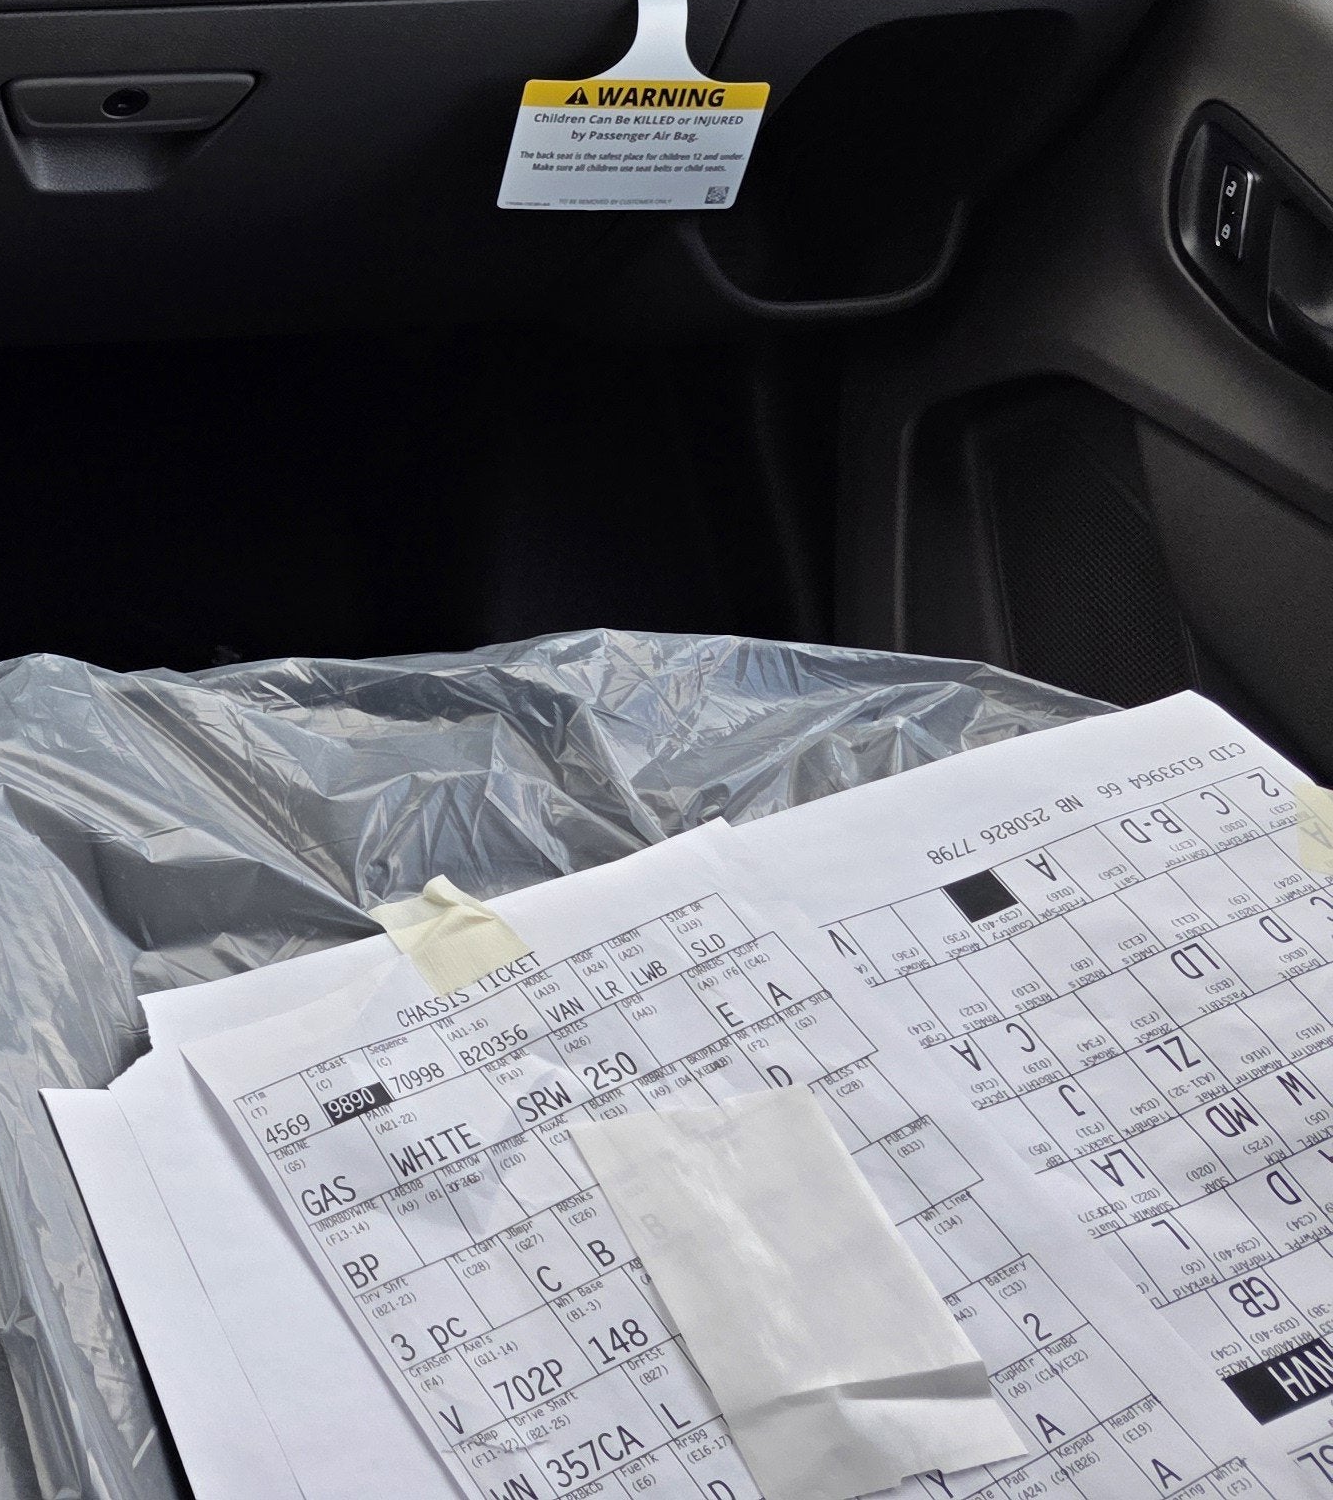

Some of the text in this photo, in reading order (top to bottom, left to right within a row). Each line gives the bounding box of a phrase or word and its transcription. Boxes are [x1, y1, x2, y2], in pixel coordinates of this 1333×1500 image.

[597, 86, 727, 108] WARNING
[533, 112, 744, 128] Children Can Be KILLED or INJURED
[570, 130, 699, 144] by Passenger Air Bag.
[520, 150, 535, 159] The
[536, 151, 554, 160] back
[556, 152, 573, 160] seat
[583, 152, 597, 160] the
[598, 152, 622, 161] safest
[622, 153, 644, 162] place
[645, 153, 657, 161] for
[658, 152, 691, 161] children
[703, 152, 719, 161] and
[719, 153, 745, 161] under.
[531, 163, 554, 171] Make
[555, 164, 574, 172] sure
[574, 163, 585, 172] all
[586, 164, 619, 172] children
[653, 165, 673, 173] belts
[684, 164, 704, 173] child
[704, 165, 727, 173] seats.
[926, 742, 1246, 865] CID 6193964 66 NB 250826 7798
[1199, 790, 1231, 815] C
[1119, 808, 1183, 844] B-D
[1025, 852, 1058, 882] A
[690, 932, 726, 958] SLD
[1258, 915, 1293, 944] D
[631, 959, 668, 987] LWB
[1170, 942, 1221, 980] LD
[595, 979, 624, 1002] LR
[766, 981, 793, 1007] A
[396, 990, 470, 1028] CHASSIS
[545, 996, 586, 1024] VAN
[716, 1001, 744, 1028] E
[459, 1023, 529, 1067] B20356
[1145, 1035, 1202, 1073] ZL
[389, 1061, 445, 1095] 70998
[583, 1051, 639, 1091] 250
[328, 1086, 376, 1119] 9890
[516, 1080, 573, 1124] SRW
[1205, 1097, 1260, 1138] MD
[265, 1113, 311, 1146] 4569
[389, 1122, 482, 1178] WHITE
[1089, 1148, 1146, 1188] LA
[301, 1175, 357, 1217] GAS
[342, 1252, 380, 1290] BP
[983, 1258, 1028, 1288] Battery
[1228, 1275, 1282, 1318] GB
[389, 1316, 468, 1363] 3 pc
[588, 1318, 650, 1366] 148
[1022, 1312, 1053, 1343] 2
[493, 1357, 564, 1411] 702P
[438, 1404, 465, 1436] V
[660, 1401, 692, 1430] L
[545, 1423, 645, 1490] 357CA
[1056, 1432, 1096, 1460] Keypad
